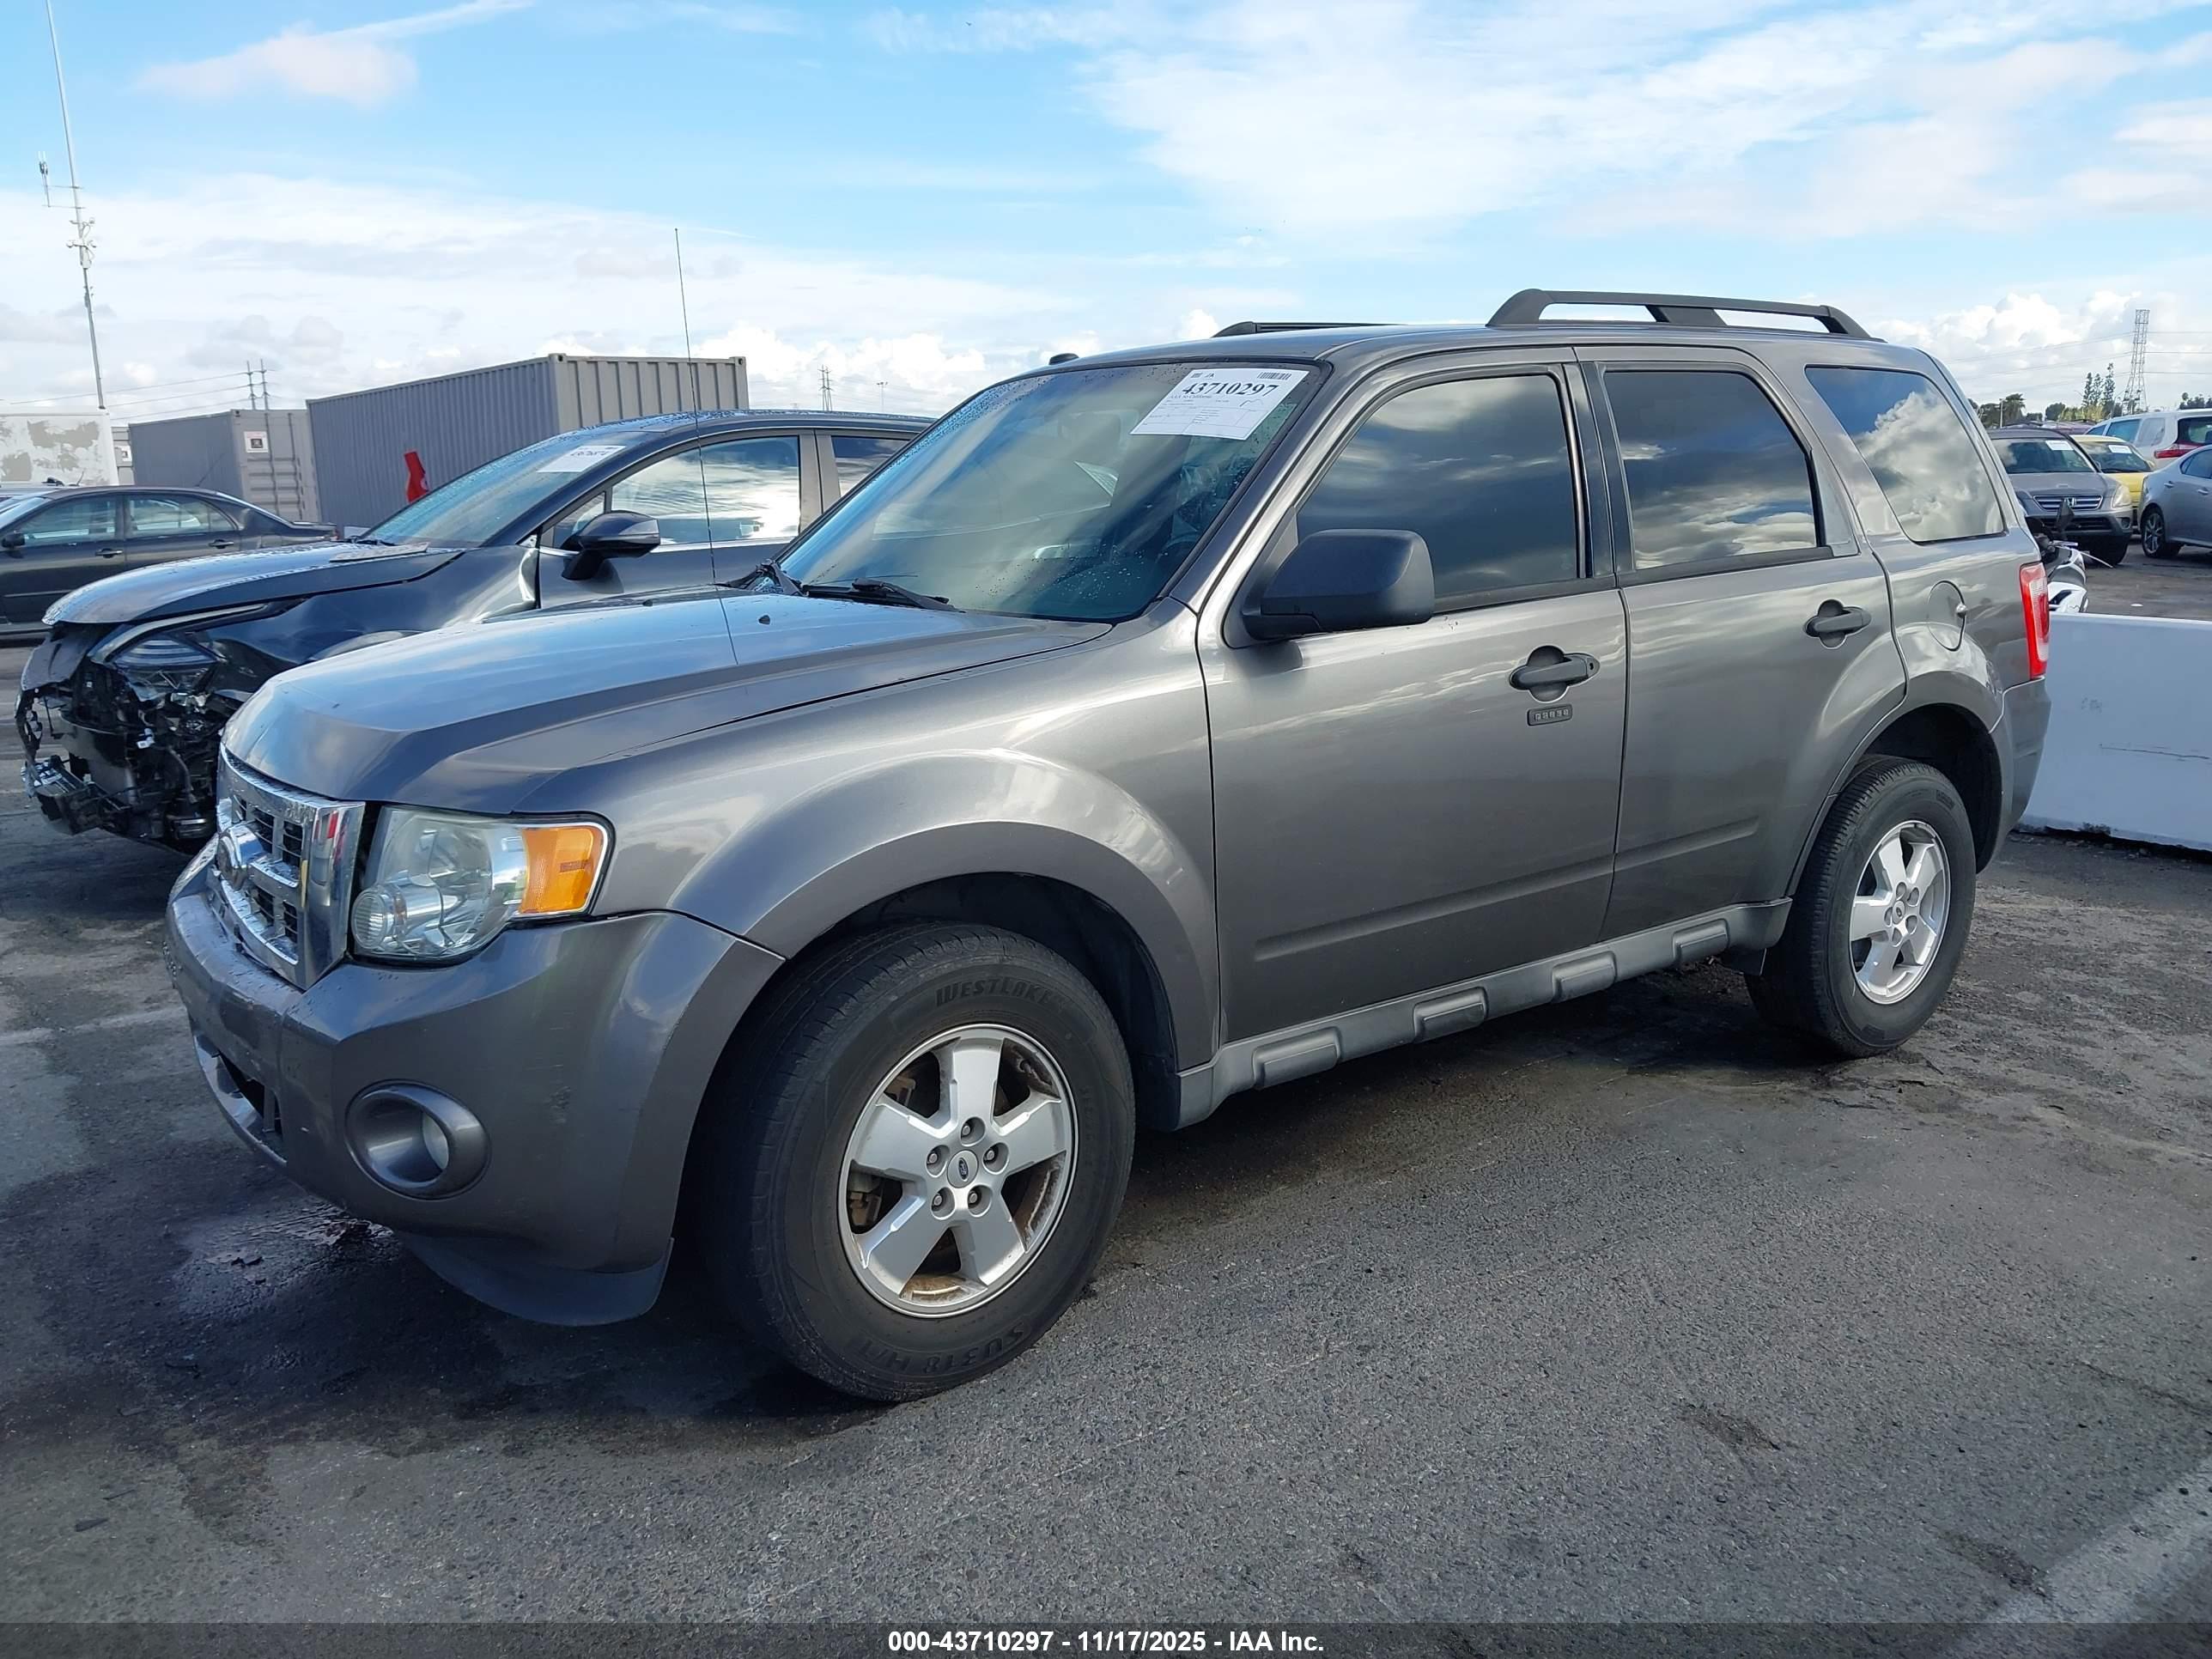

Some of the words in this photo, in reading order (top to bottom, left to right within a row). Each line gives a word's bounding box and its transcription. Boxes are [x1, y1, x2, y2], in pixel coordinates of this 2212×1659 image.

[1182, 382, 1279, 397] 43710297
[935, 975, 1053, 1007] WESTLAKE
[923, 1322, 1025, 1374] SU318
